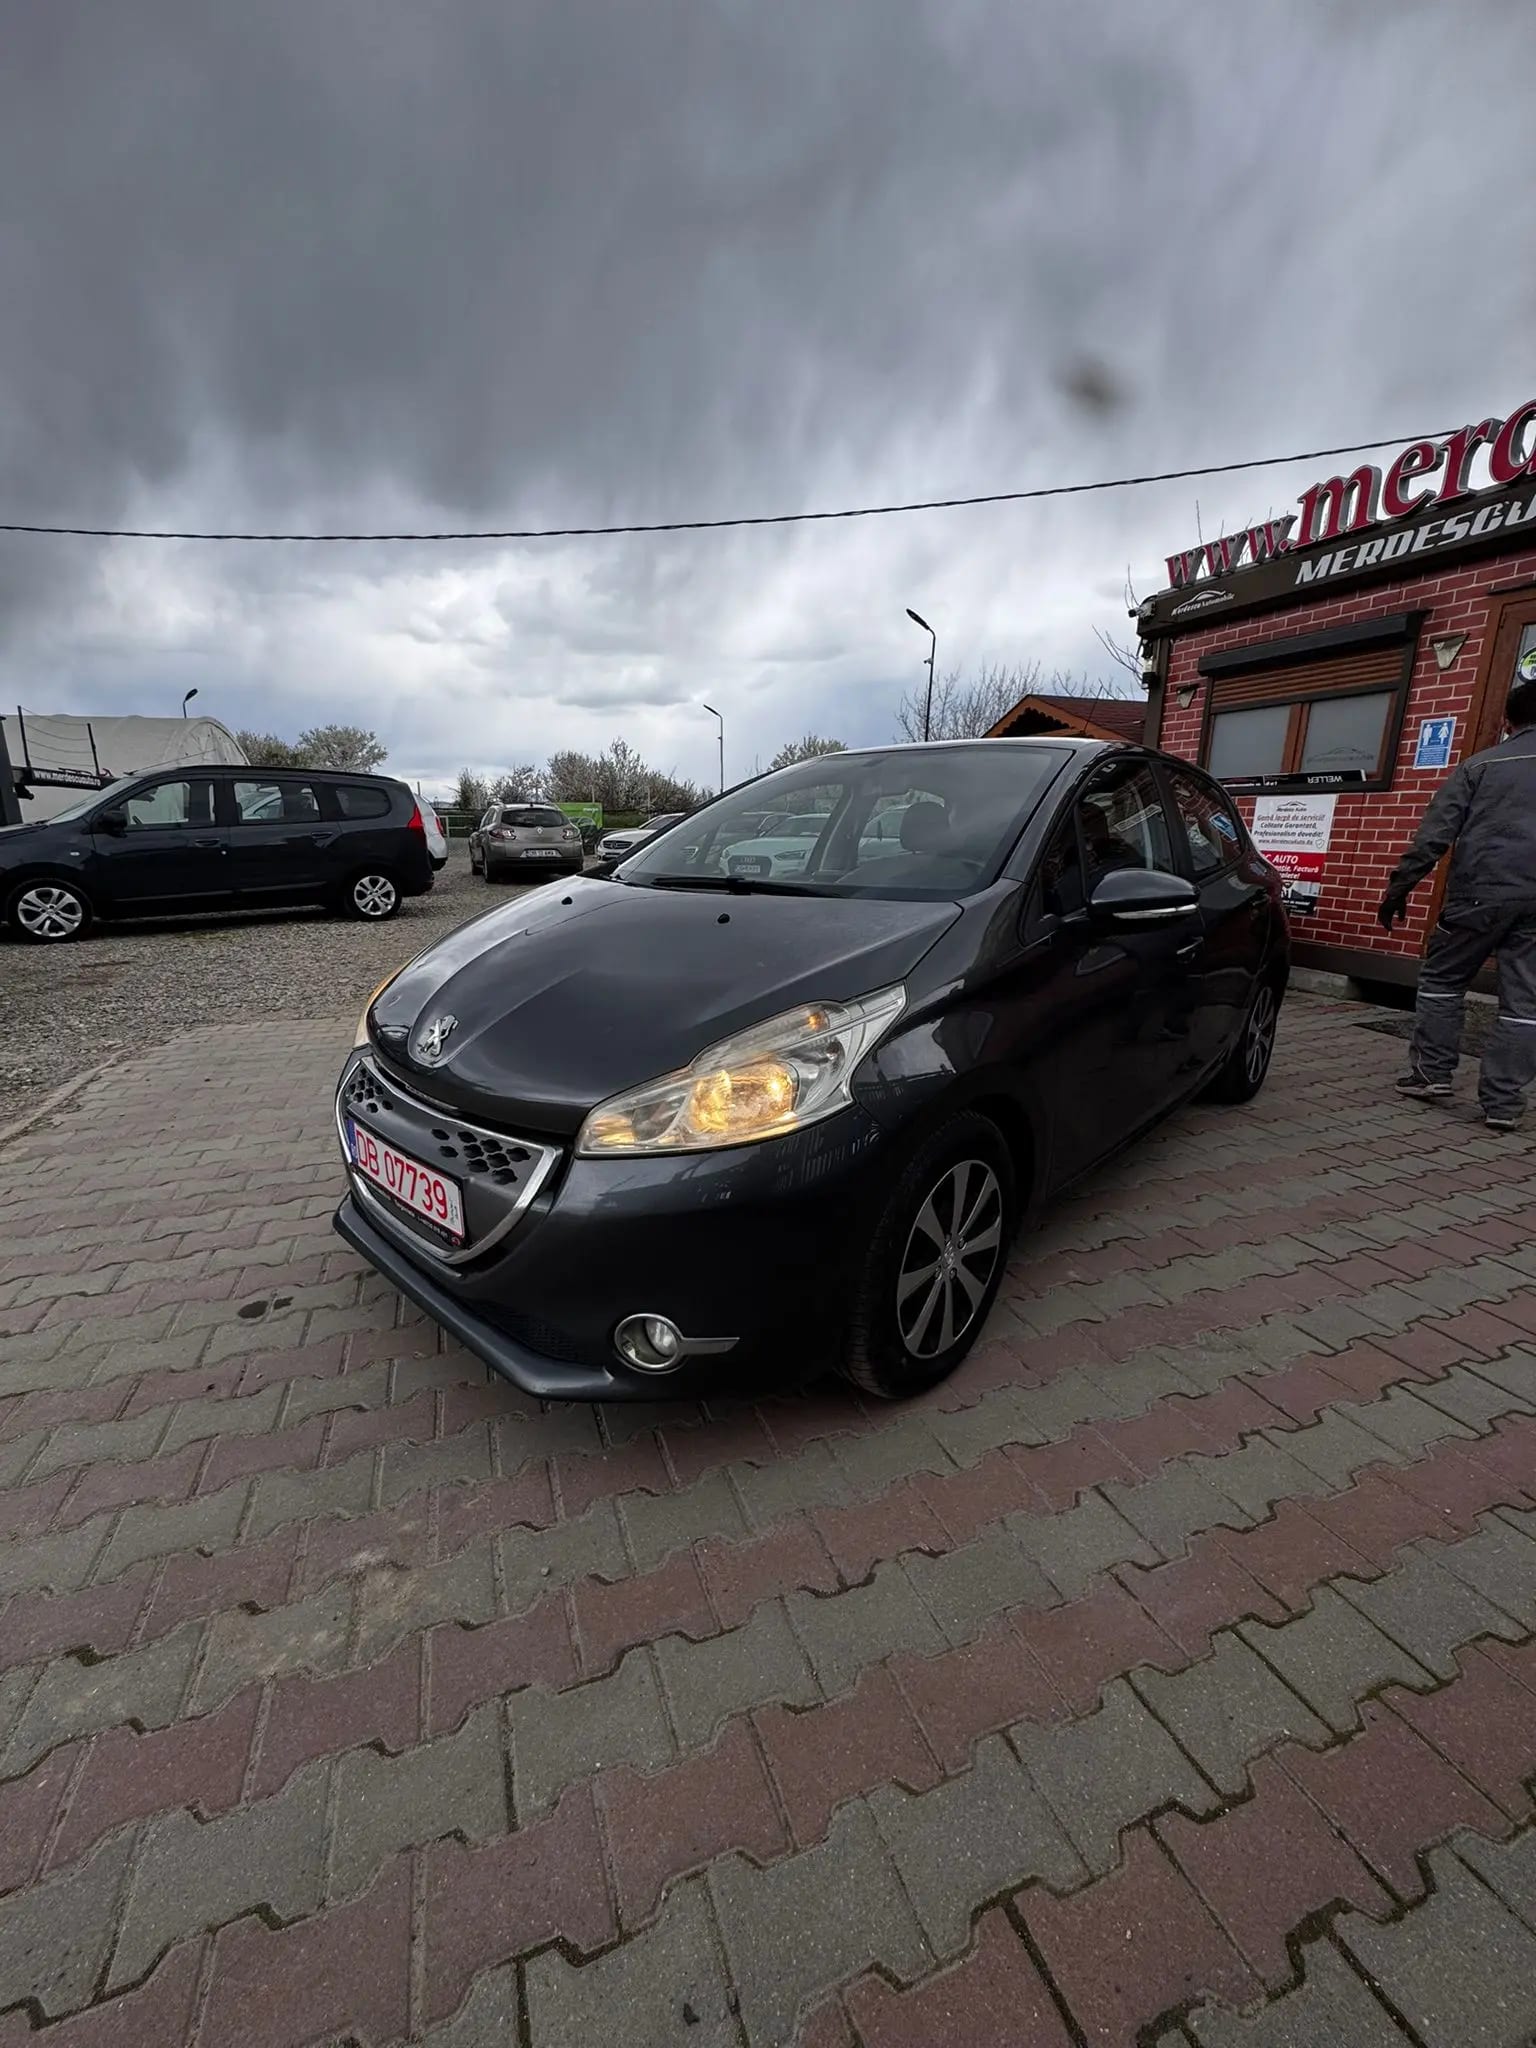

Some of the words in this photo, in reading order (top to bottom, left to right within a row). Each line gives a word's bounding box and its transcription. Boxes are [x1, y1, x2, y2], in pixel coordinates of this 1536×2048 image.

[1307, 775, 1343, 785] WELLER
[1272, 854, 1299, 864] AUTO
[356, 1129, 380, 1176] DB
[384, 1150, 448, 1220] 07739
